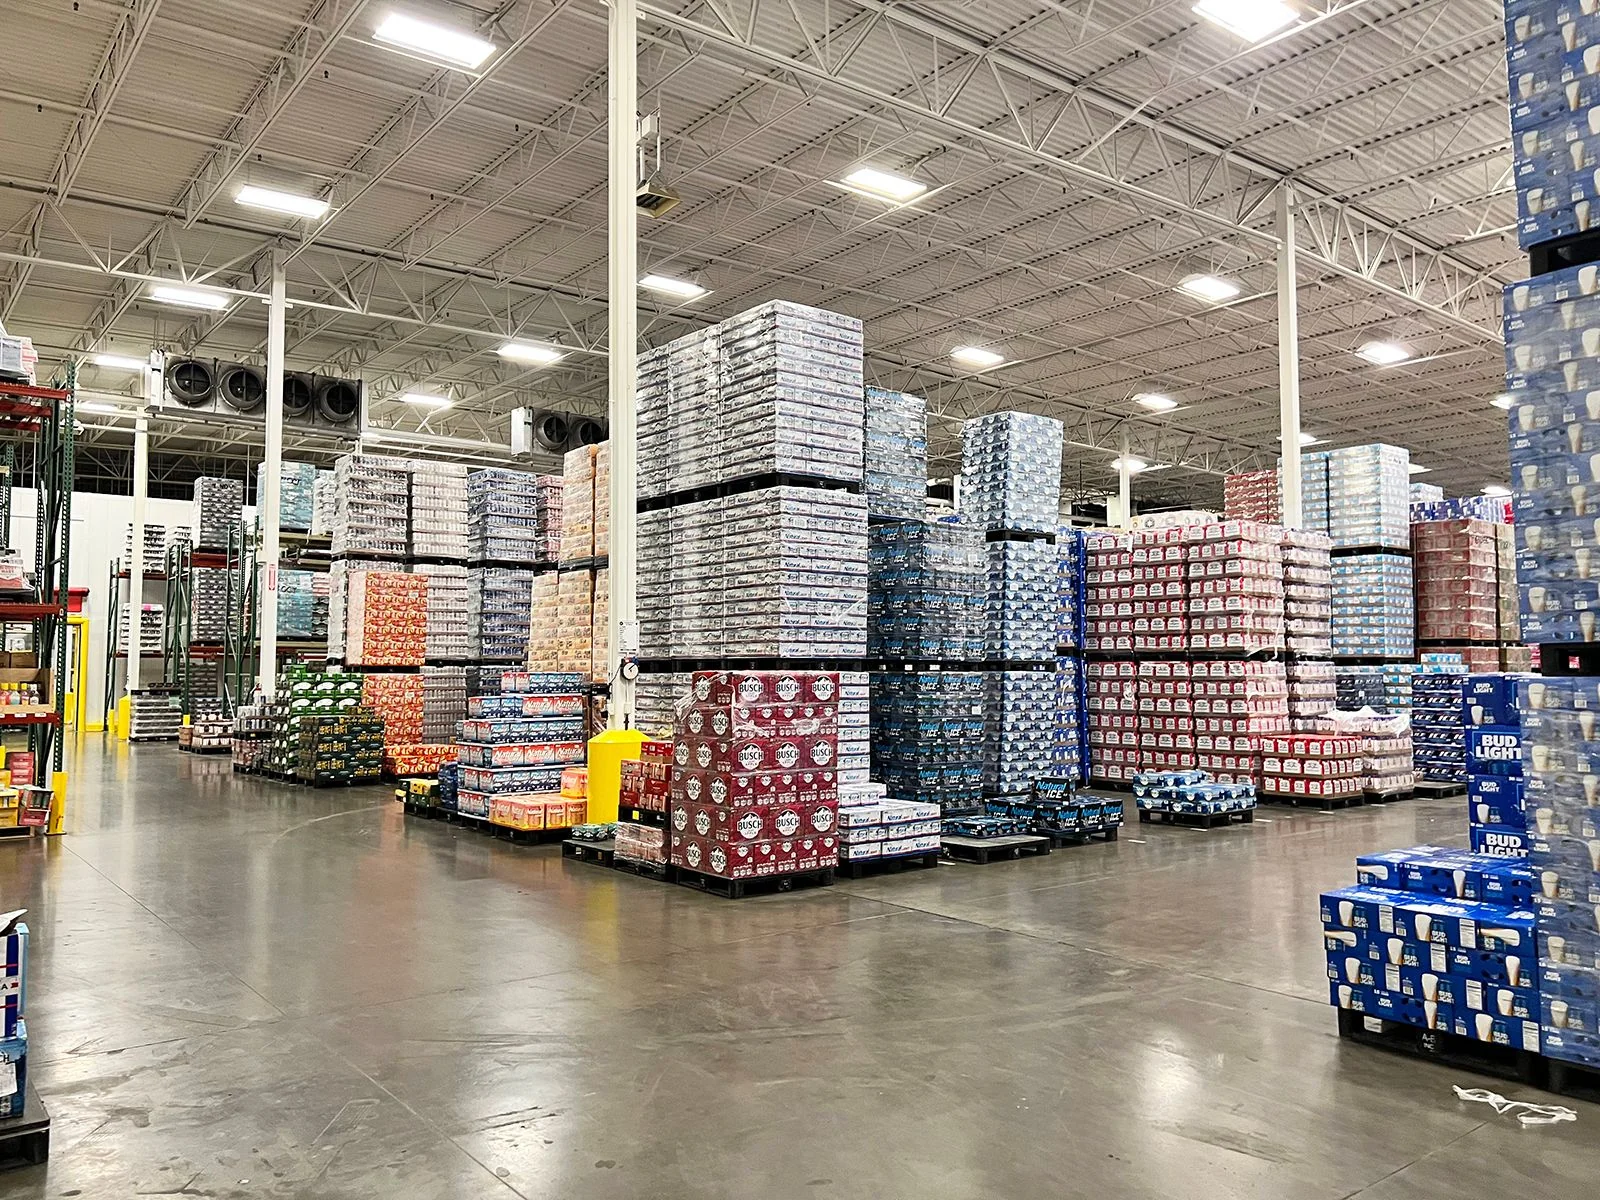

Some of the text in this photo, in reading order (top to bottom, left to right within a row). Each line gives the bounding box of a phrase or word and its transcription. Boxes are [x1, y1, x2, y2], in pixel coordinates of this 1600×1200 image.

[739, 684, 763, 693] BUSCH
[776, 684, 800, 692] BUSCH
[812, 684, 835, 692] BUSCH
[1482, 735, 1517, 747] BUD
[739, 752, 763, 760] BUSCH
[776, 751, 800, 759] BUSCH
[812, 749, 833, 758] BUSCH
[1476, 746, 1521, 760] LIGHT
[1036, 781, 1067, 790] Natural
[1046, 790, 1064, 798] ICE
[1058, 809, 1078, 819] Natural
[1082, 808, 1101, 817] Natural
[1103, 805, 1122, 814] Natural
[812, 814, 834, 824] BUSCH
[1088, 815, 1099, 823] ICE
[1110, 812, 1121, 821] ICE
[738, 820, 762, 830] BUSCH
[776, 817, 800, 827] BUSCH
[1065, 818, 1076, 826] ICE
[1486, 833, 1521, 847] BUD
[1480, 845, 1529, 857] LIGHT
